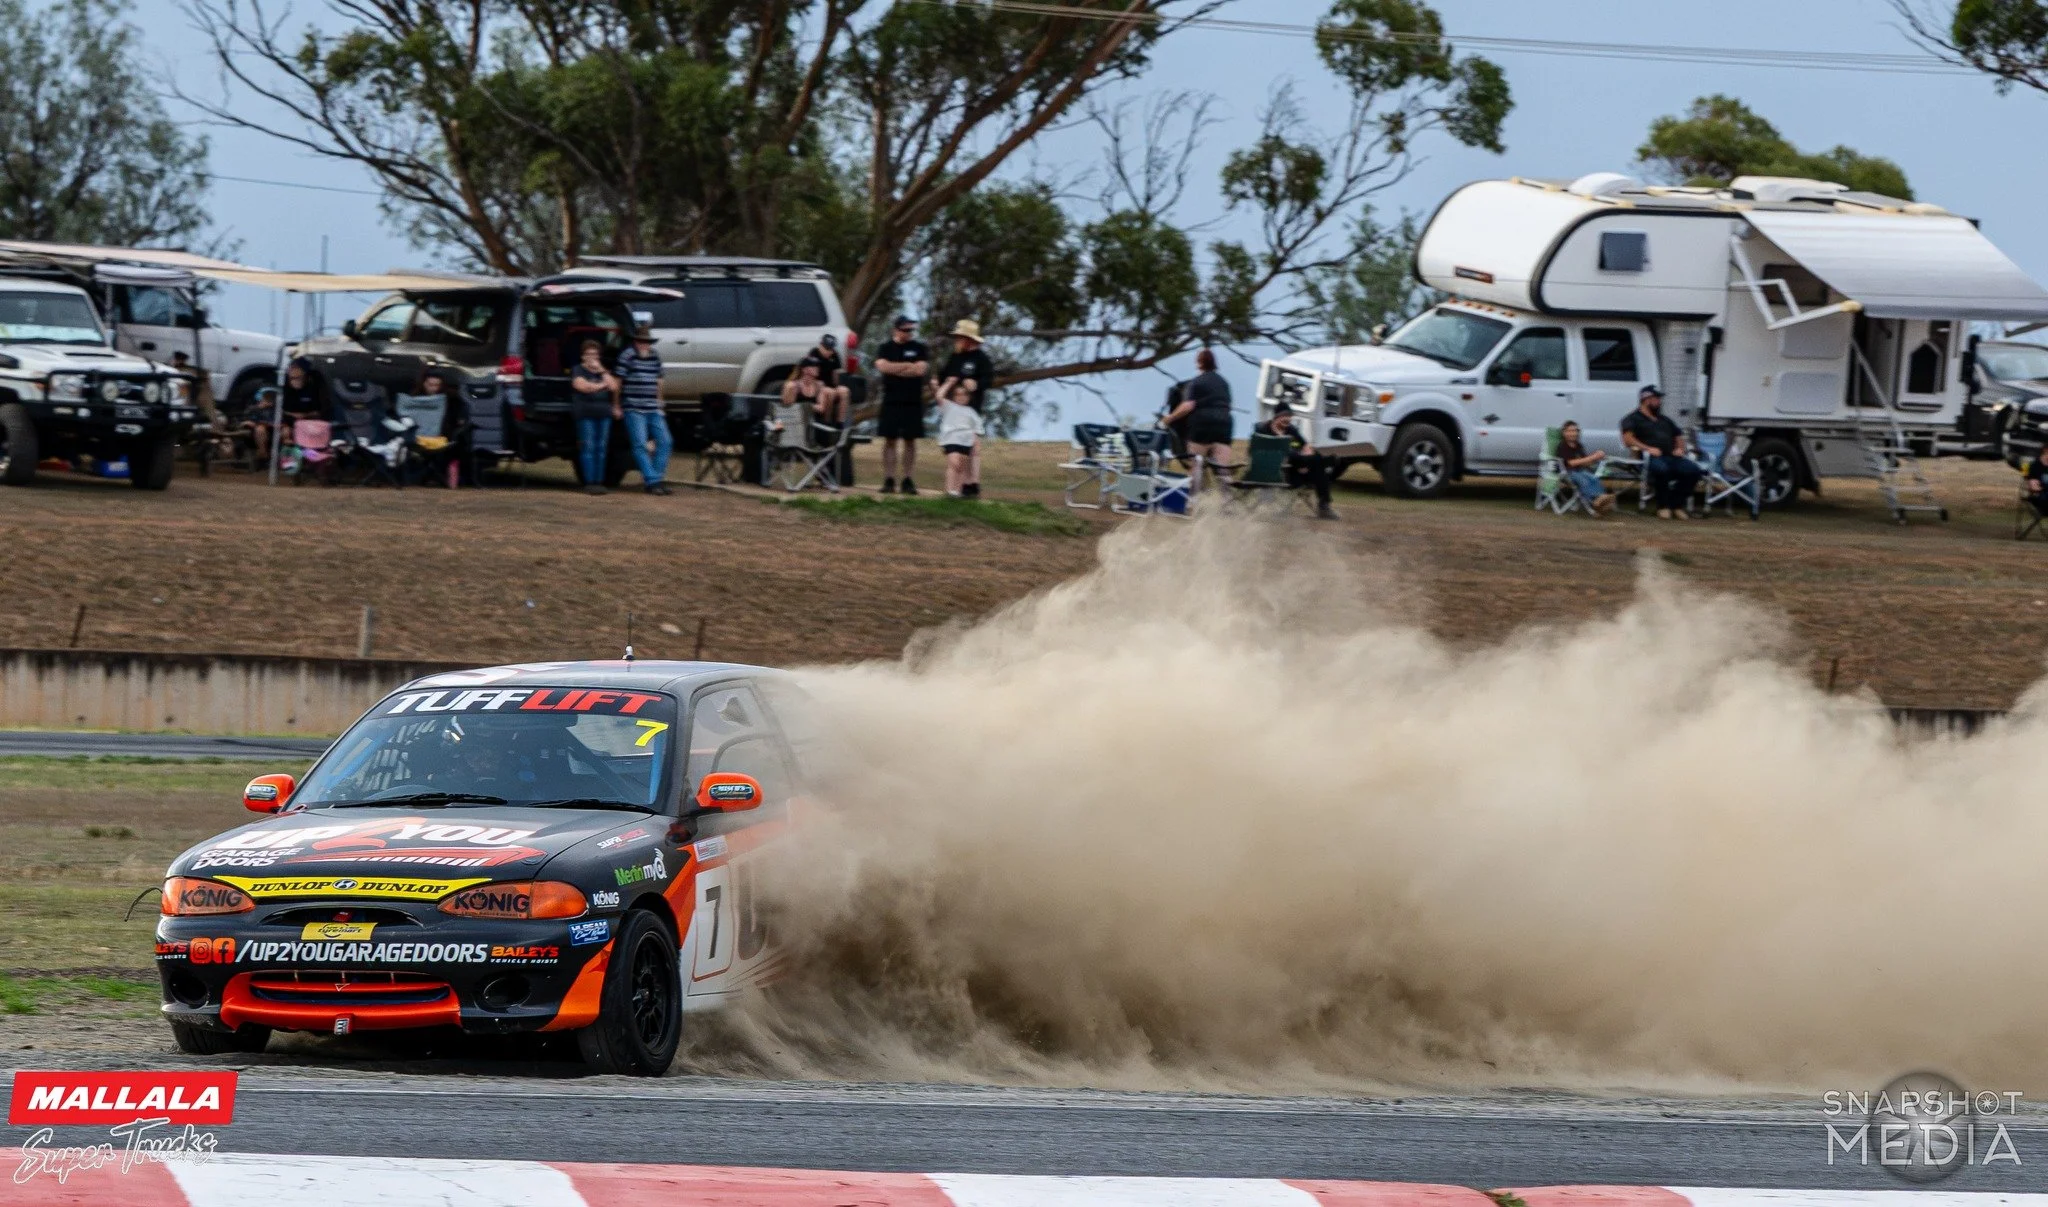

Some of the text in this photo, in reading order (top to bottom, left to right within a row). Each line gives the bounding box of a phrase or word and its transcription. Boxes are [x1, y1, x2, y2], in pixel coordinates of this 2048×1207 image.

[387, 689, 662, 714] TUFFLIFT
[635, 720, 669, 747] 7
[201, 848, 304, 858] GARAGE
[191, 857, 279, 870] DOORS
[181, 885, 243, 908] KÖNIG
[249, 881, 449, 894] DUNLOP DUNLOP
[455, 889, 531, 912] KÖNIG
[592, 890, 620, 906] KÖNIG
[705, 884, 722, 960] 7
[490, 945, 560, 958] BAILEY'S
